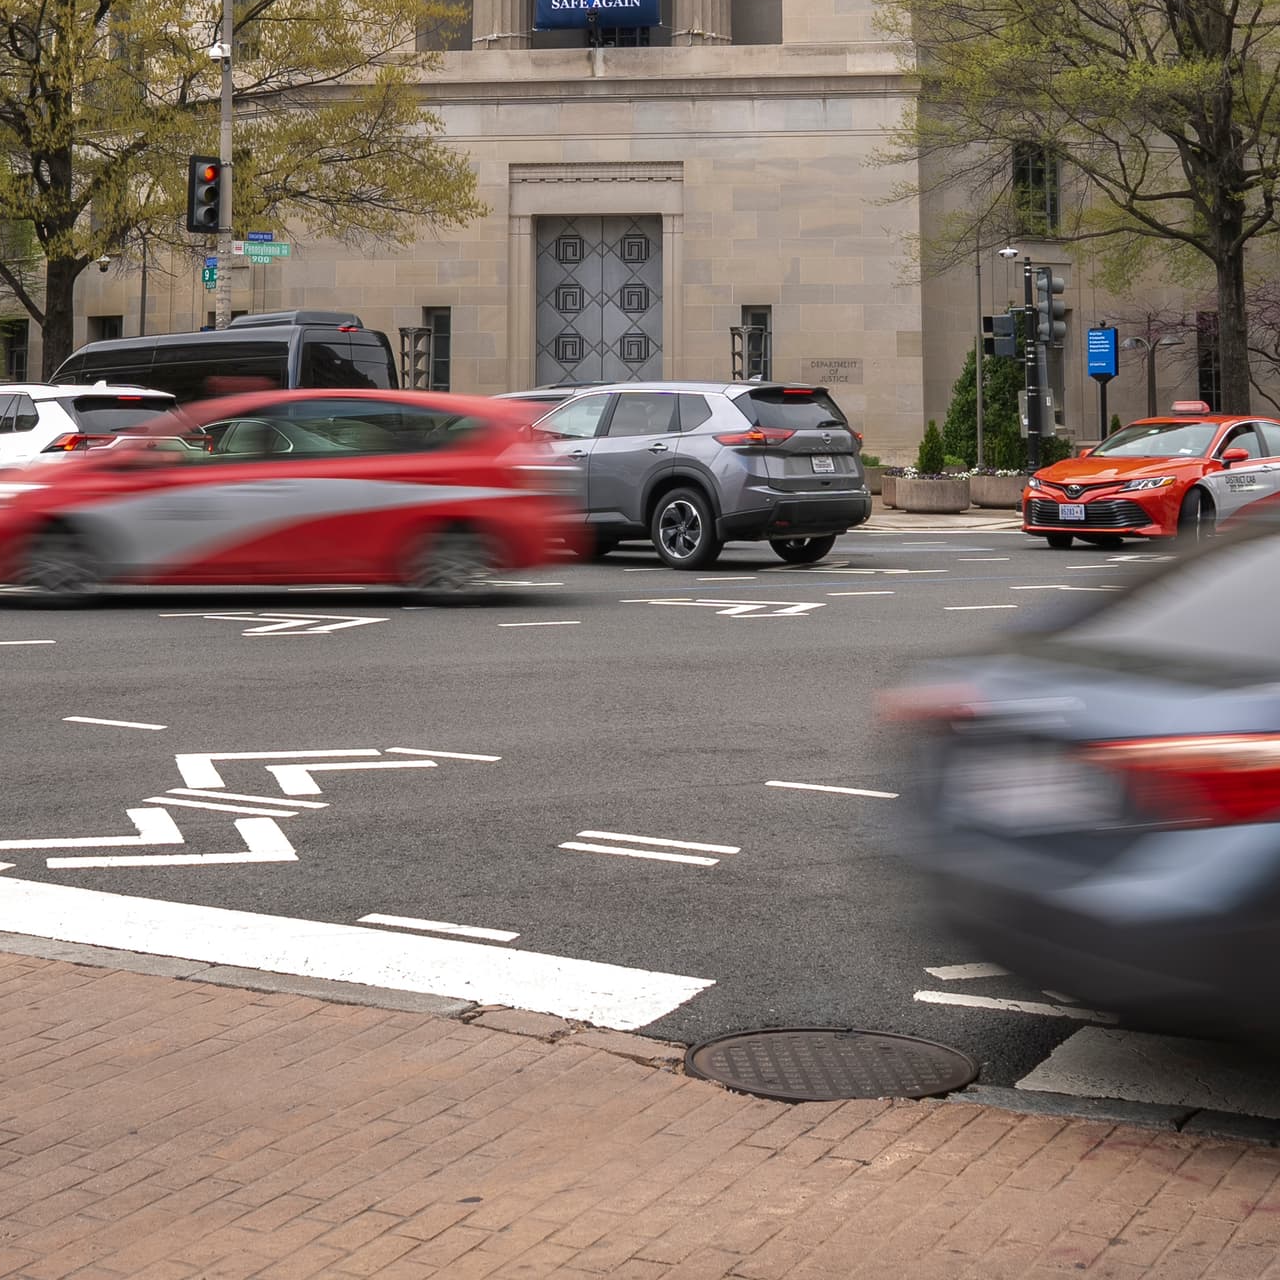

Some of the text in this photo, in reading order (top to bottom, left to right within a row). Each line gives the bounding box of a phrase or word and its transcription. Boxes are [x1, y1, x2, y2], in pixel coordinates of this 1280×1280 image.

[252, 255, 270, 264] 900
[810, 361, 857, 369] DEPARTMENT
[819, 375, 849, 383] JUSTICE
